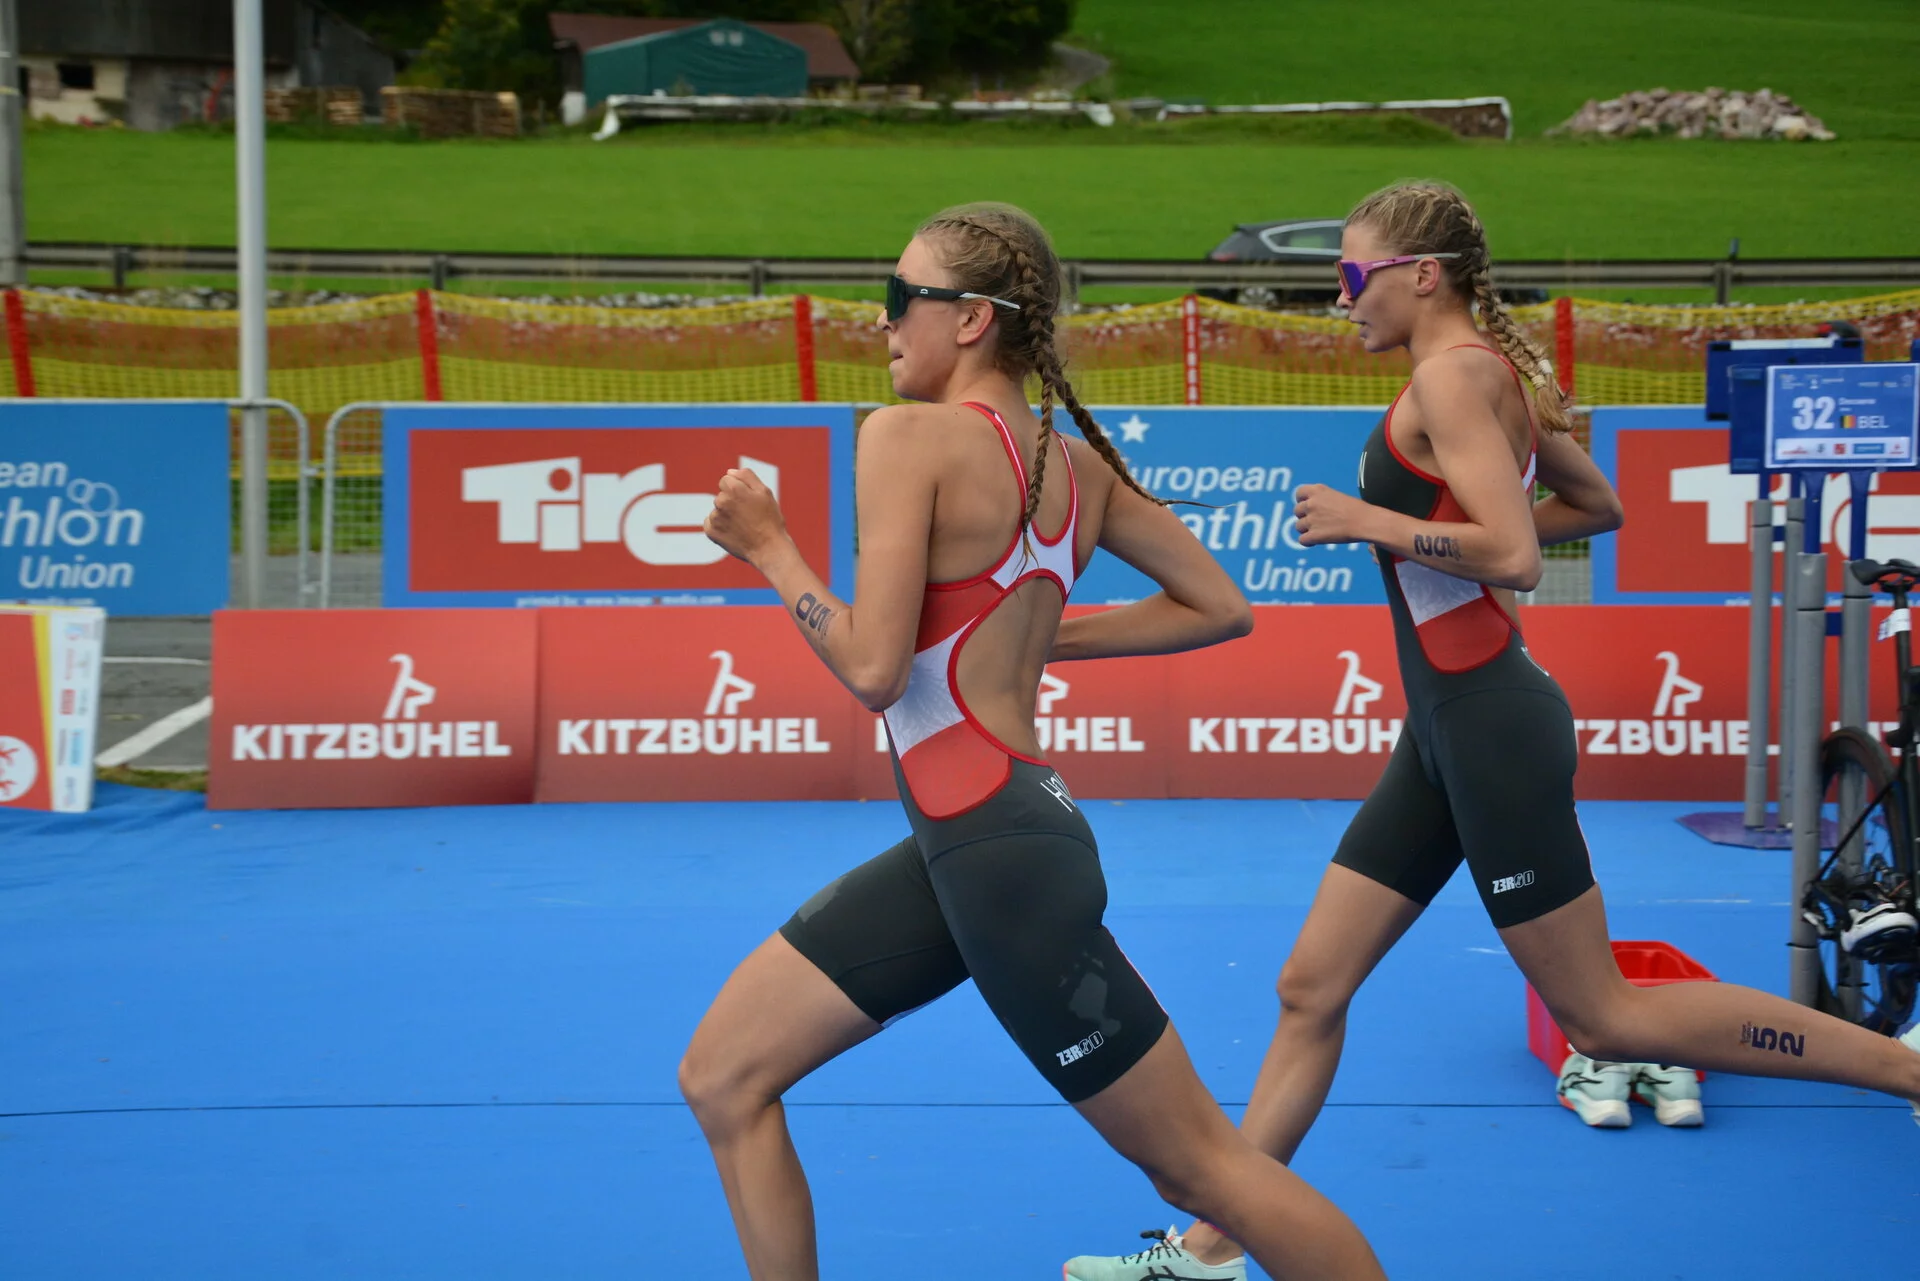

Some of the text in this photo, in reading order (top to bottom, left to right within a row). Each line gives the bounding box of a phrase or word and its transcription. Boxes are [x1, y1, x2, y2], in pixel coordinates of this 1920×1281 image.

[1792, 396, 1836, 430] 32
[1857, 415, 1889, 429] BEL
[1123, 457, 1292, 498] uropean
[0, 496, 144, 547] hlon
[462, 456, 779, 565] Tiro
[19, 554, 134, 589] Union
[1244, 558, 1353, 592] Union
[232, 721, 511, 760] KITZBÜHEL
[557, 718, 831, 755] KITZBÜHEL
[1752, 1027, 1805, 1057] 52
